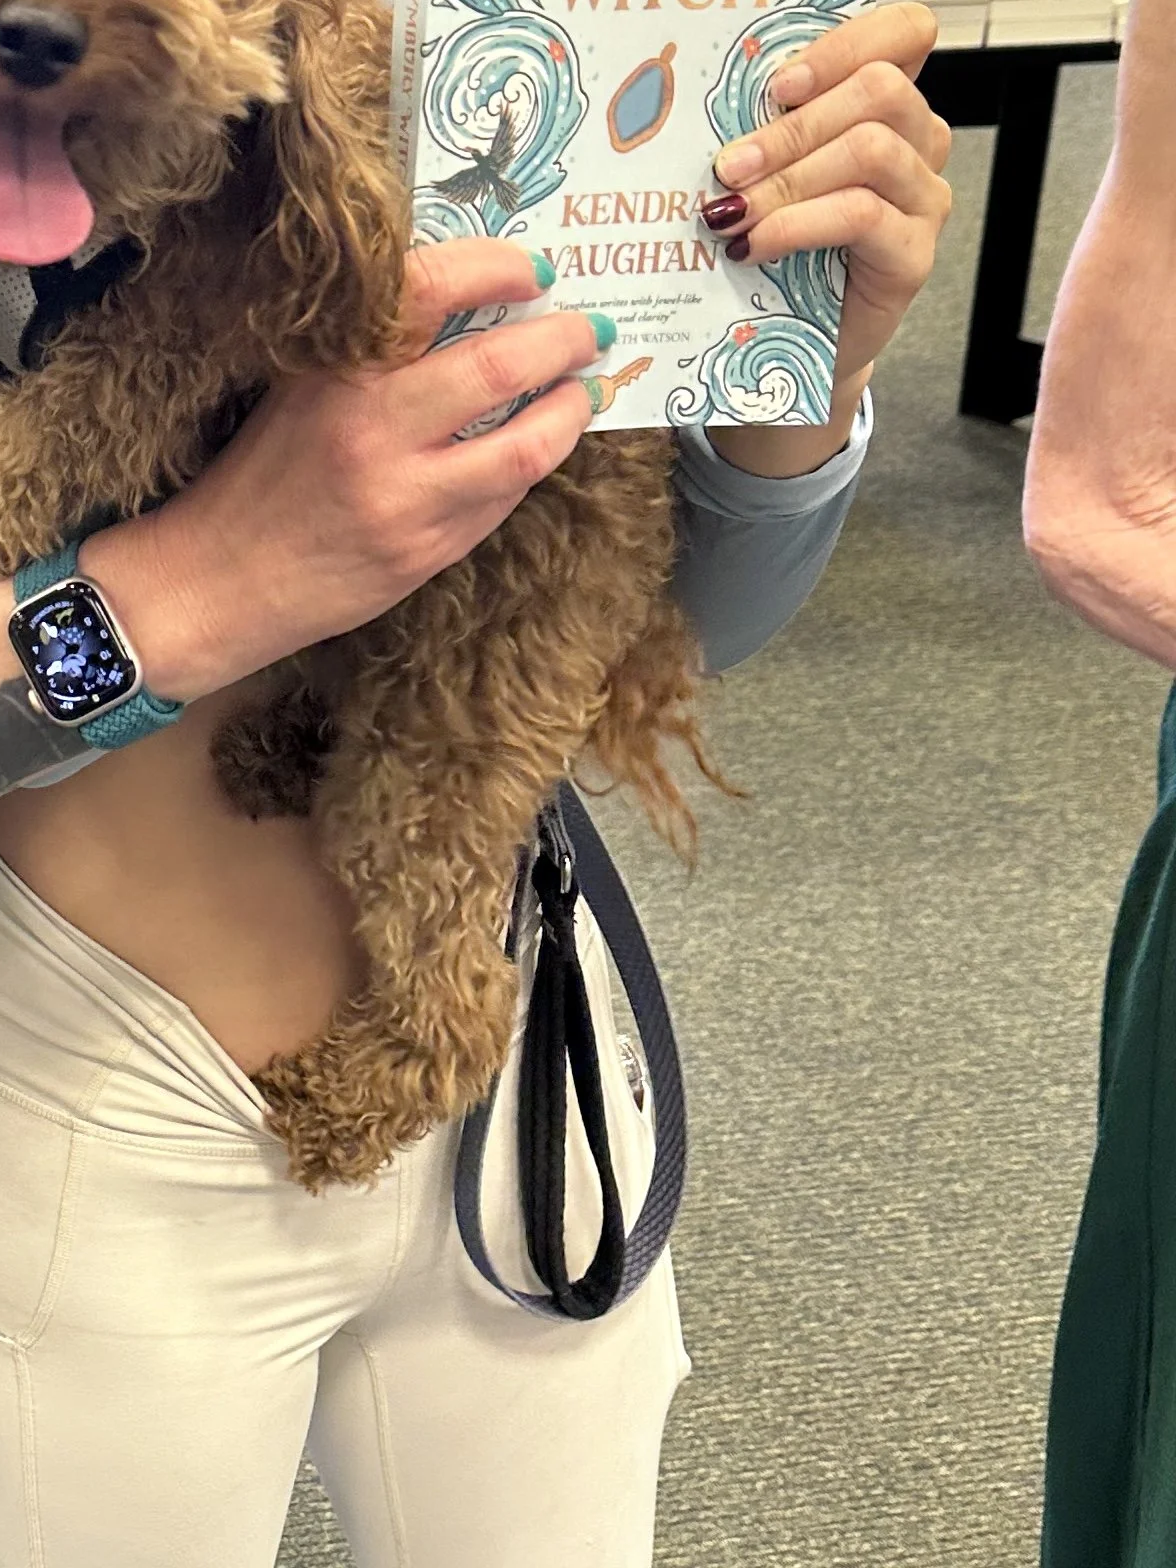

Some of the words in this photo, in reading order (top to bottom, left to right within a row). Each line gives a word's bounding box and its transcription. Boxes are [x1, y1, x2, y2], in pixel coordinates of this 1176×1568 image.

[396, 106, 414, 184] WITC
[560, 189, 708, 228] KENDRA
[542, 239, 719, 279] VAUGHAN
[599, 297, 628, 308] writes
[631, 295, 652, 307] with
[652, 294, 702, 309] jewel-like
[616, 312, 635, 323] and
[639, 331, 690, 344] WATSON
